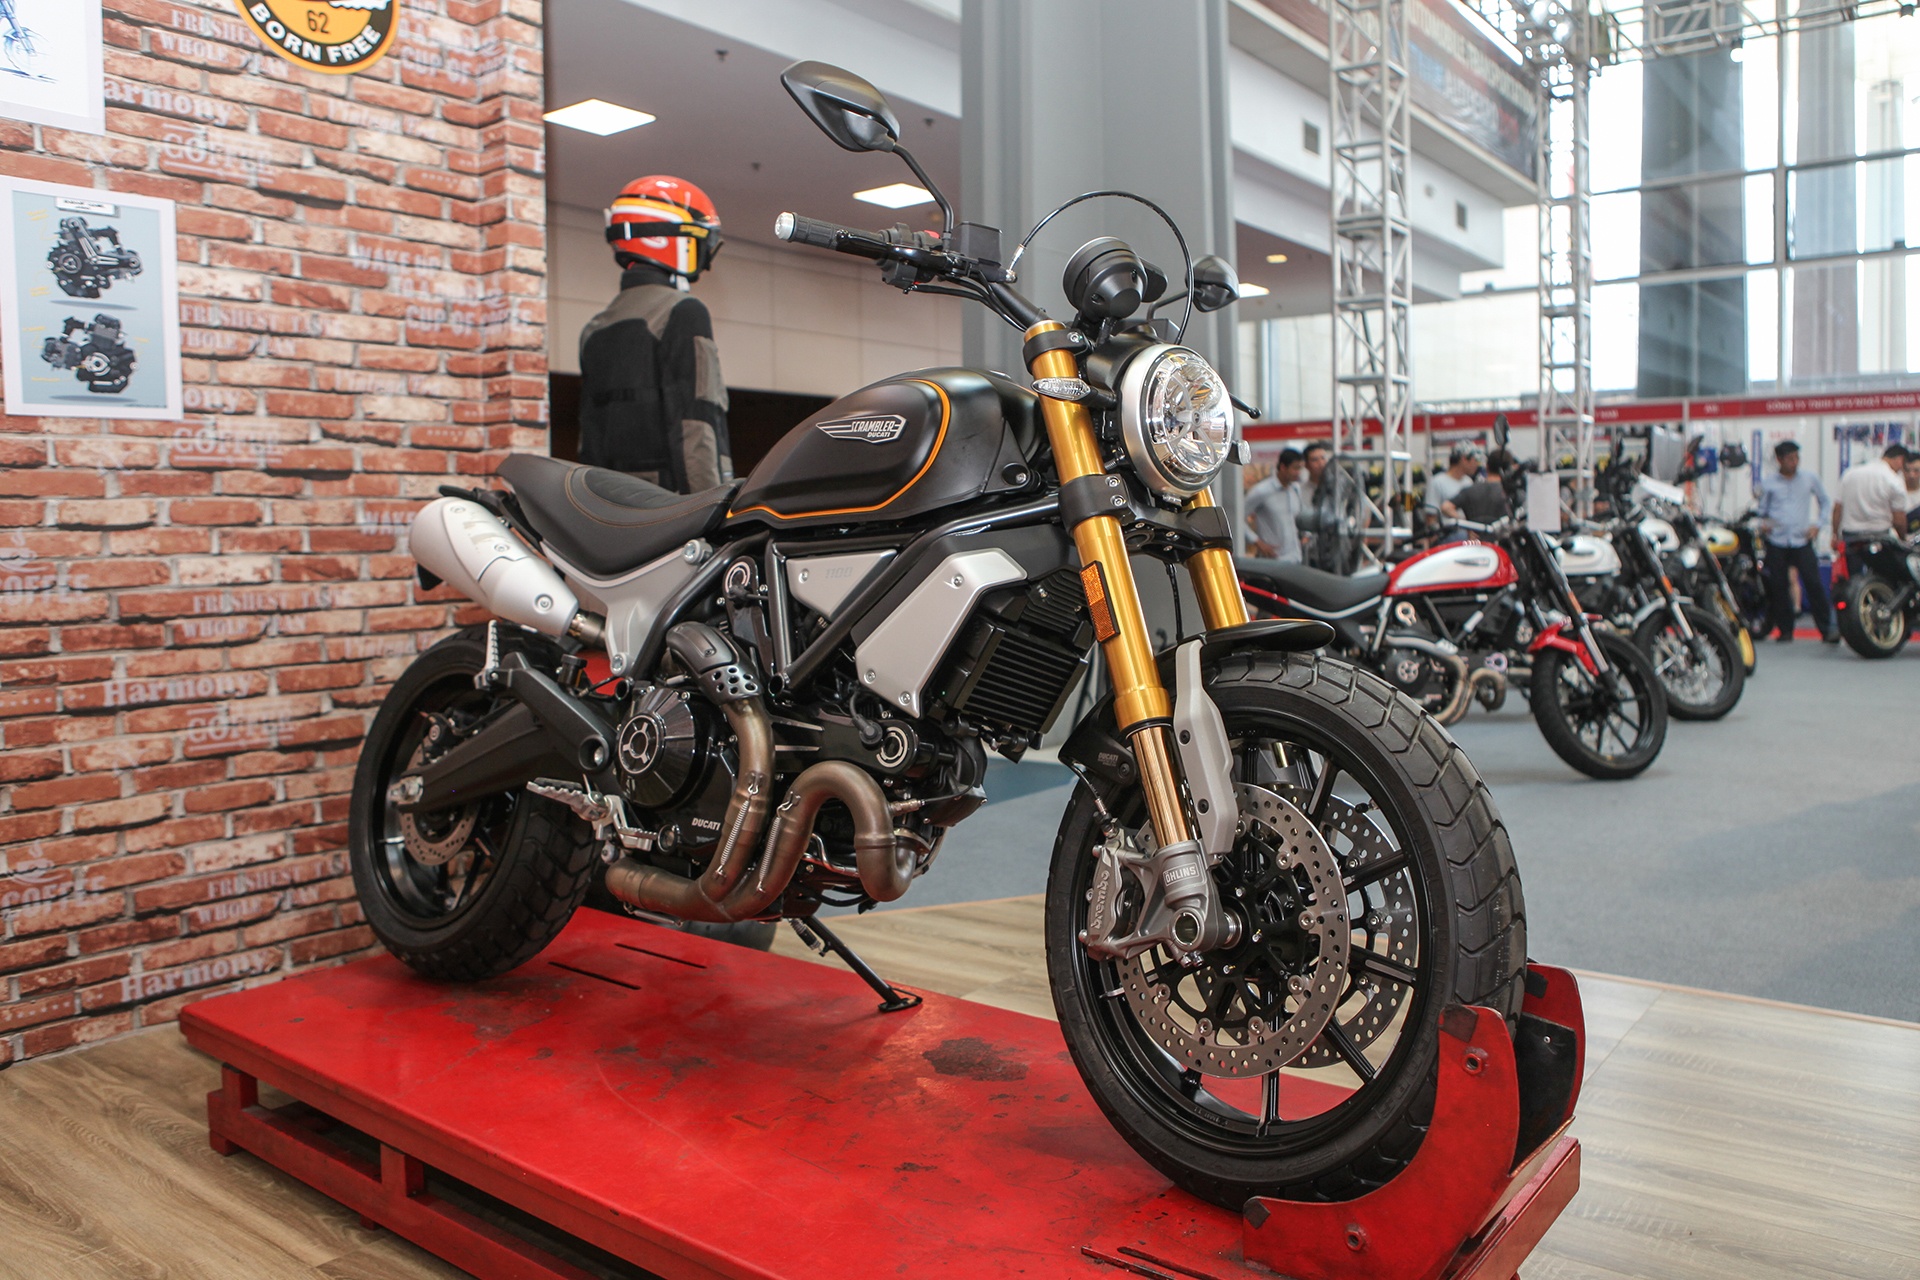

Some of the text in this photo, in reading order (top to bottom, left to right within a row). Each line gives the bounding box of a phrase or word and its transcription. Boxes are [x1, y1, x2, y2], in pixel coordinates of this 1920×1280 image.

[250, 3, 321, 62] BORN
[326, 24, 382, 63] FREE
[306, 10, 331, 35] 62
[104, 78, 234, 127] armony
[405, 304, 447, 332] CUP
[181, 329, 236, 351] HOLE
[851, 420, 896, 433] SCRAMBLER
[825, 567, 853, 579] 1100
[0, 573, 91, 607] OFFEE
[102, 672, 254, 707] Harmony
[691, 817, 721, 831] DUCATI
[1164, 866, 1197, 884] ÖHLINS
[121, 950, 269, 1002] Harmony
